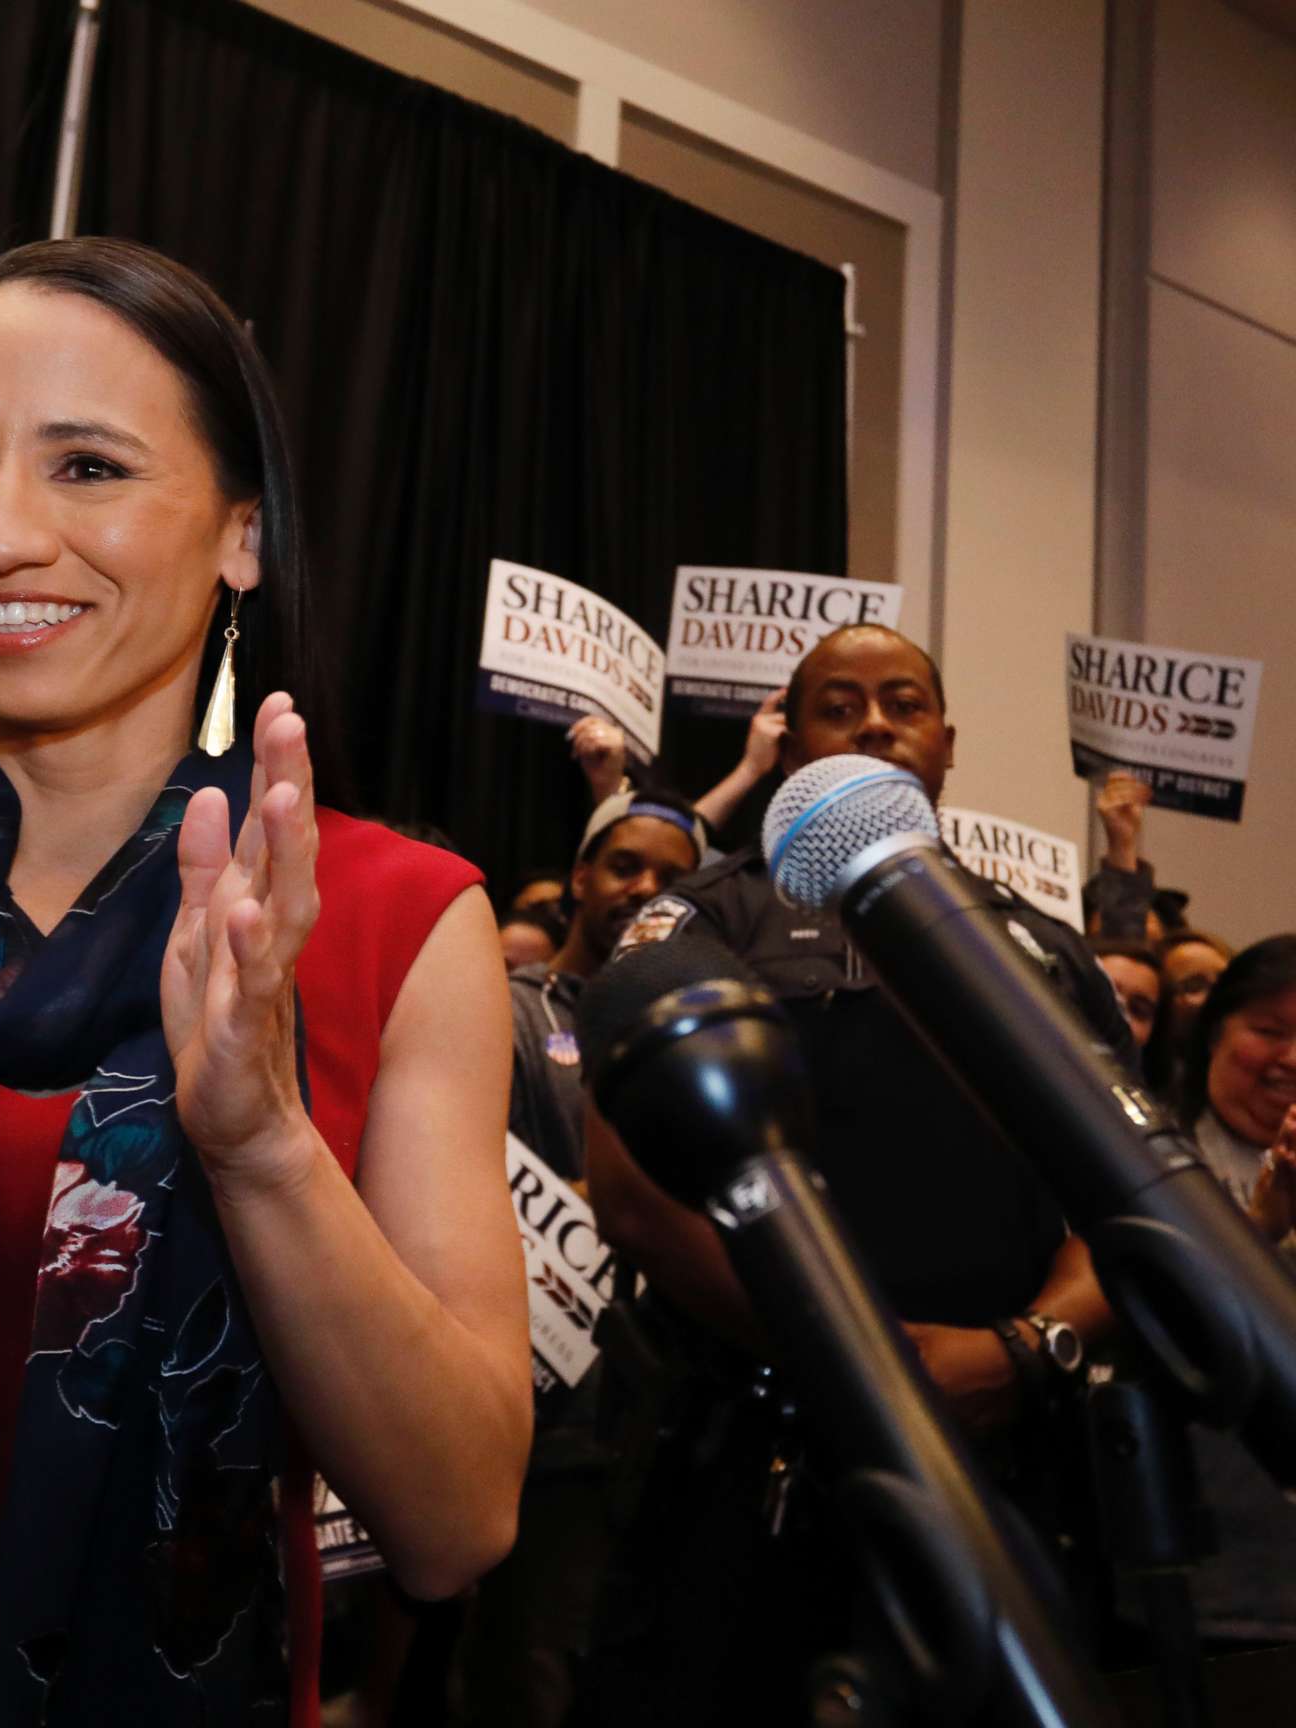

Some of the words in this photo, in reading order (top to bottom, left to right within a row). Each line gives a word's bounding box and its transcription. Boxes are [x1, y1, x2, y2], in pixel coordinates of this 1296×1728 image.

[502, 574, 660, 687] SHARICE
[682, 576, 885, 626] SHARICE
[501, 614, 625, 690] DAVIDS
[680, 617, 805, 656] DAVIDS
[1070, 641, 1246, 710] SHARICE
[1070, 684, 1171, 737] DAVIDS
